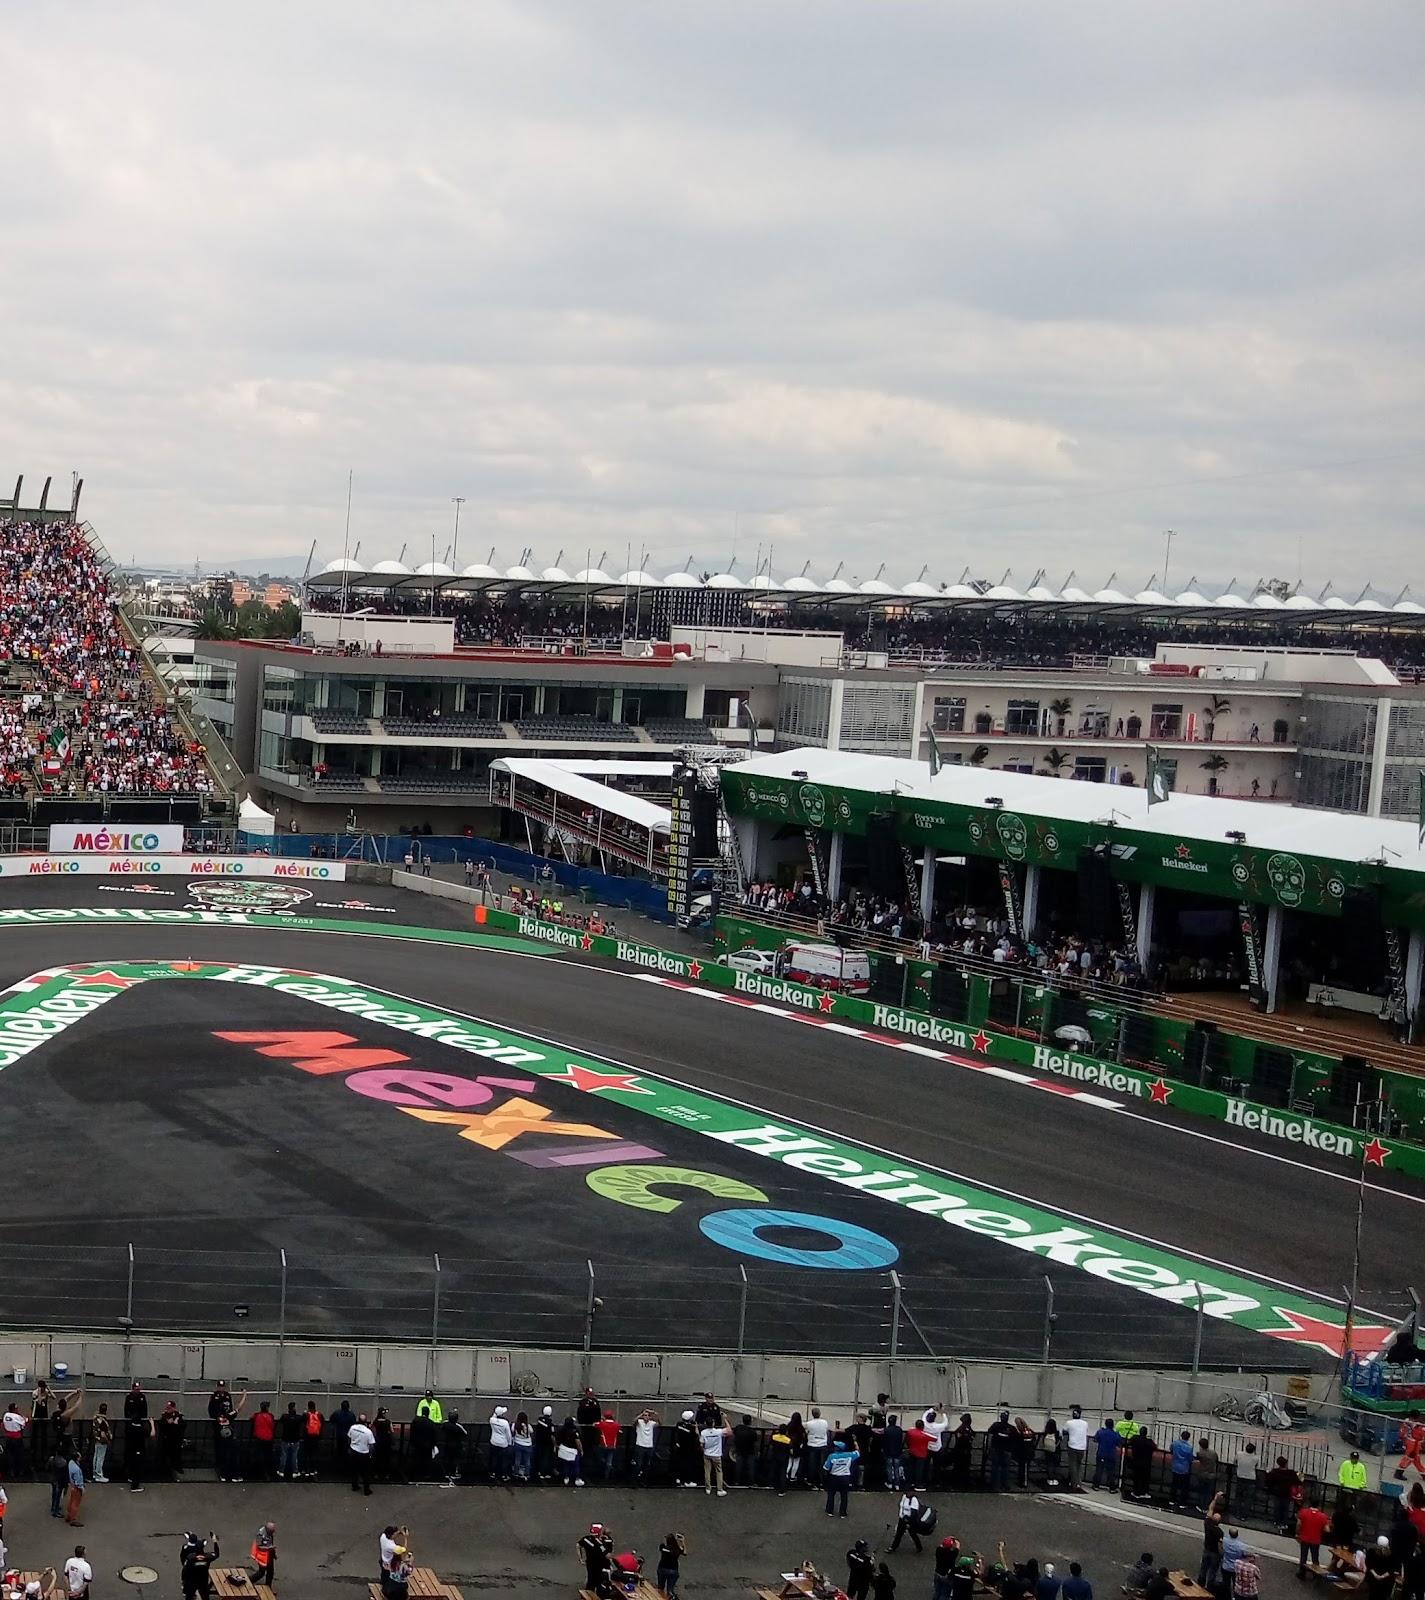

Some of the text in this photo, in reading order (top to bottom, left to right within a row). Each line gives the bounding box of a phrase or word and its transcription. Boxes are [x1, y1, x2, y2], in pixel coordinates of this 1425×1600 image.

[1161, 857, 1209, 873] Heineken
[676, 893, 687, 904] LEC
[518, 918, 577, 948] Heineken
[616, 942, 685, 976] Heineken
[1244, 934, 1259, 985] Heineken
[734, 971, 814, 1009] Heineken
[203, 964, 547, 1067] Heineken
[873, 1005, 966, 1047] Heineken
[1032, 1046, 1142, 1097] Heineken
[1224, 1098, 1354, 1157] Heineken
[712, 1124, 1262, 1320] Heineken
